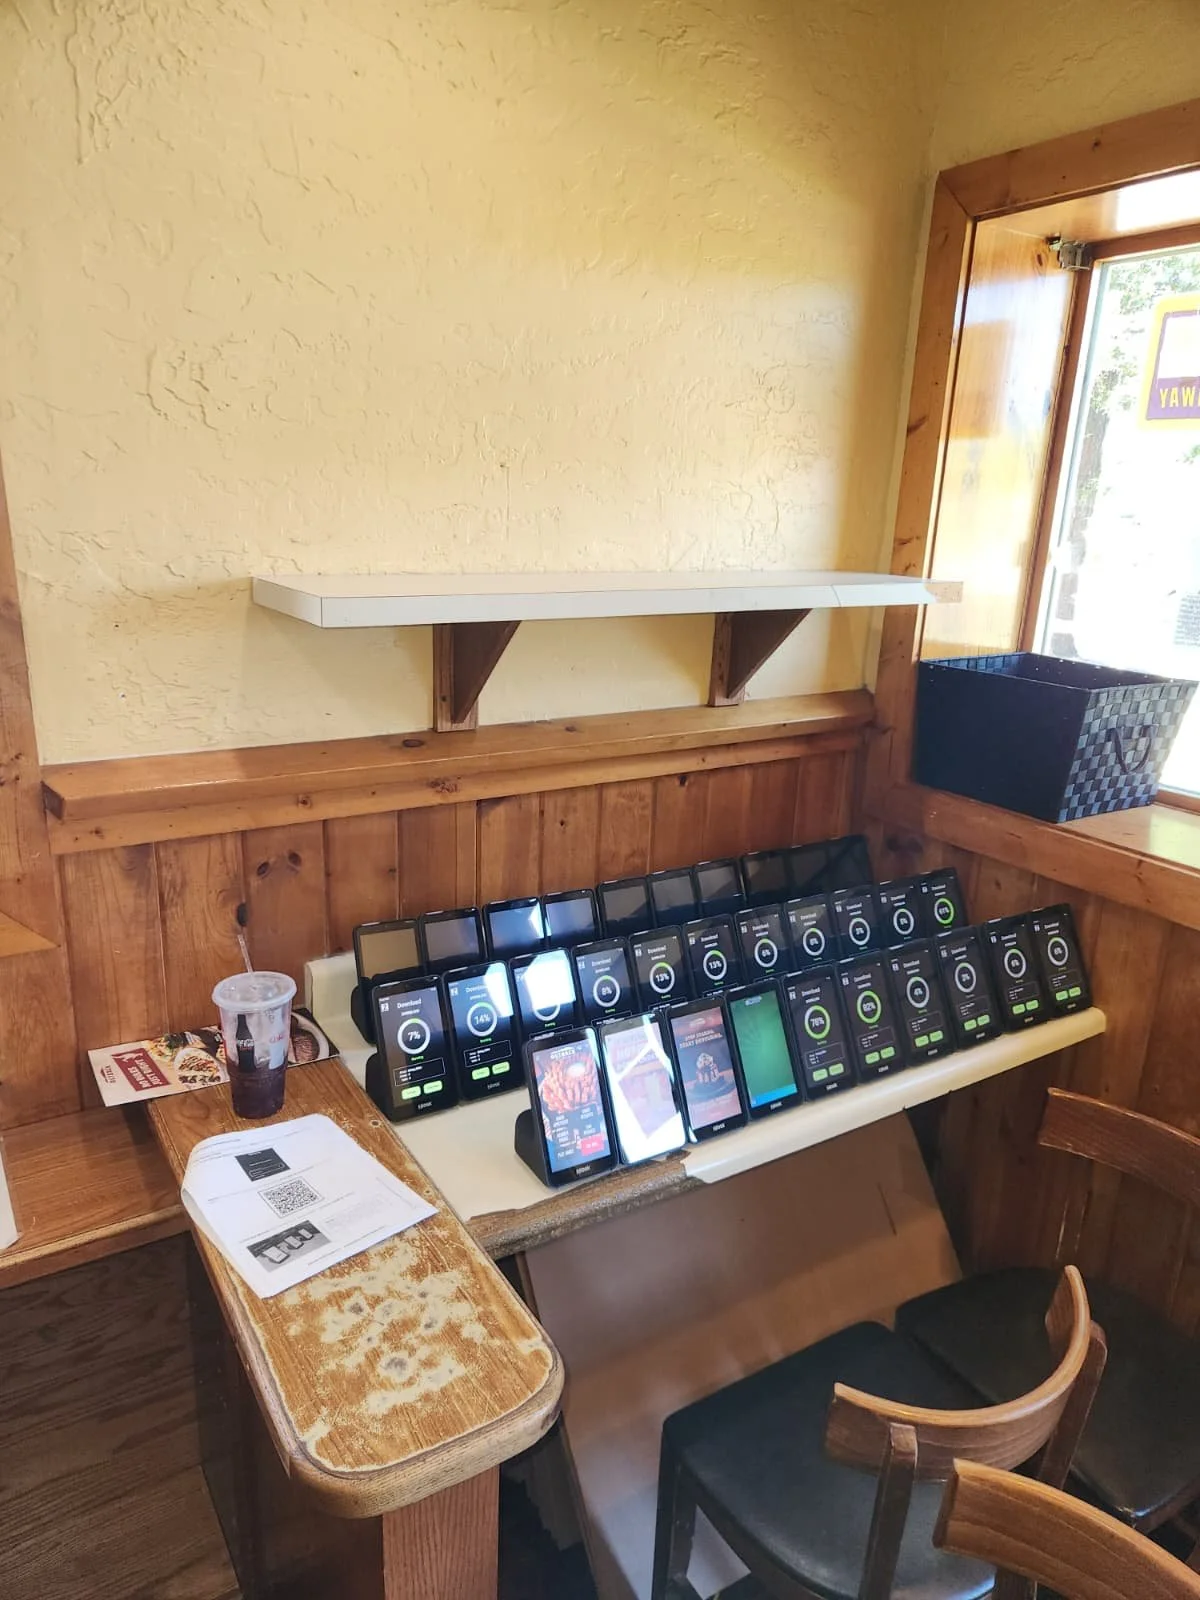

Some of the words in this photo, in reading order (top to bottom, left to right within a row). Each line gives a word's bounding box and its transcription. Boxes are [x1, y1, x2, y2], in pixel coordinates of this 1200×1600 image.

[397, 998, 422, 1009] Download
[474, 1014, 490, 1025] 14%
[407, 1031, 420, 1042] 7%
